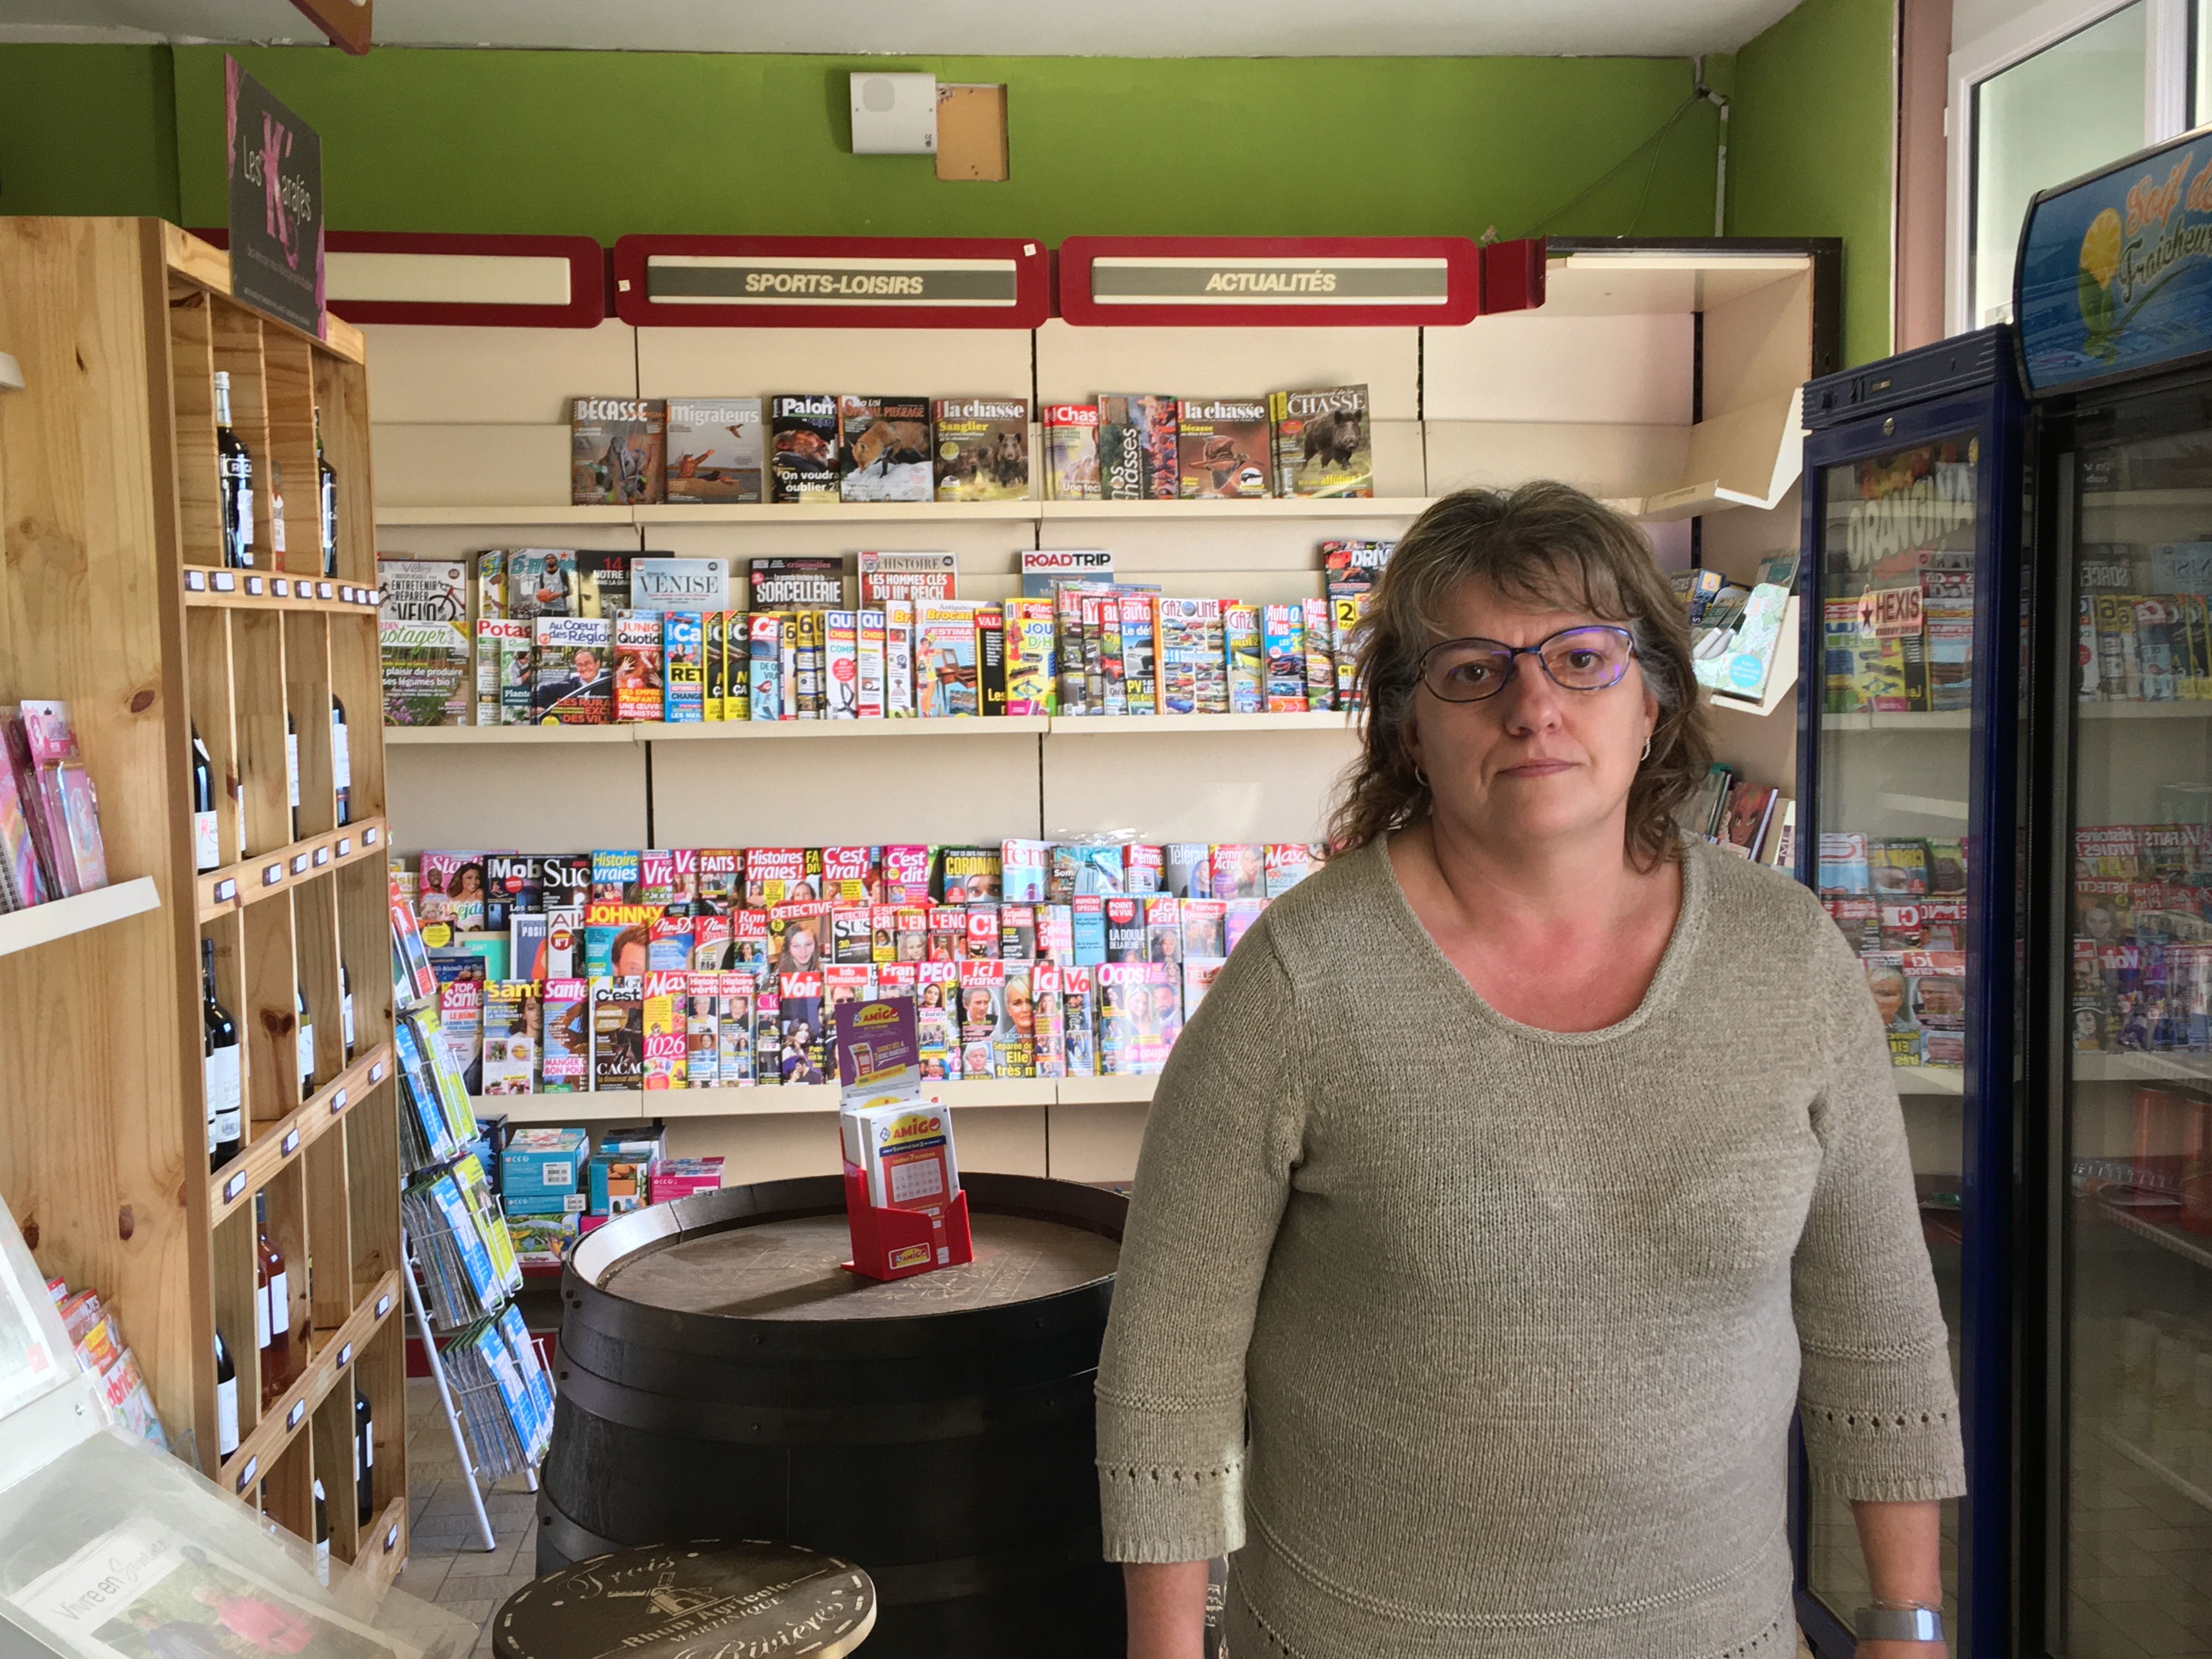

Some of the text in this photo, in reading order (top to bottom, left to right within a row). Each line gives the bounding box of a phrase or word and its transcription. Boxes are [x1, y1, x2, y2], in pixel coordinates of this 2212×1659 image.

[244, 135, 262, 187] Les
[745, 274, 924, 294] SPORTS-LOISIRS
[1205, 270, 1336, 291] ACTUALITÉS
[577, 397, 648, 422] BÉCASSE
[944, 400, 1025, 418] la chasse
[1185, 402, 1265, 419] la chasse
[1287, 394, 1365, 415] CHASSE
[939, 421, 989, 432] Sanglier
[782, 471, 798, 481] On
[785, 482, 826, 492] oublier
[1848, 466, 1973, 570] ORANGINA
[593, 570, 623, 579] NOTRE
[869, 573, 947, 585] LES HOMMES CLÉS
[641, 576, 719, 593] VENISE
[757, 582, 840, 602] SORCELLERIE
[873, 585, 890, 600] DU
[911, 586, 944, 600] REICH
[1876, 589, 1920, 623] HEXIS
[549, 622, 562, 630] Au
[549, 630, 567, 638] des
[386, 667, 463, 676] plaisir de produire
[399, 677, 435, 686] légumes
[748, 850, 803, 866] Histoires
[823, 847, 866, 864] C'est
[888, 851, 924, 867] C'est
[701, 856, 733, 872] FAITS
[748, 865, 795, 880] vraies
[586, 906, 664, 923] JOHNNY
[770, 901, 832, 919] DETECTIVE
[1109, 929, 1120, 940] LA
[974, 962, 993, 975] ici
[828, 975, 867, 983] Dimanche
[963, 975, 1003, 986] France
[454, 983, 473, 993] TOP
[444, 986, 482, 1008] Santé
[1007, 1052, 1028, 1063] Elle
[996, 1064, 1021, 1076] très
[893, 1117, 941, 1139] AMIGO
[622, 1581, 792, 1648] Rhum Agricole
[669, 1596, 782, 1643] MARTINIQUE
